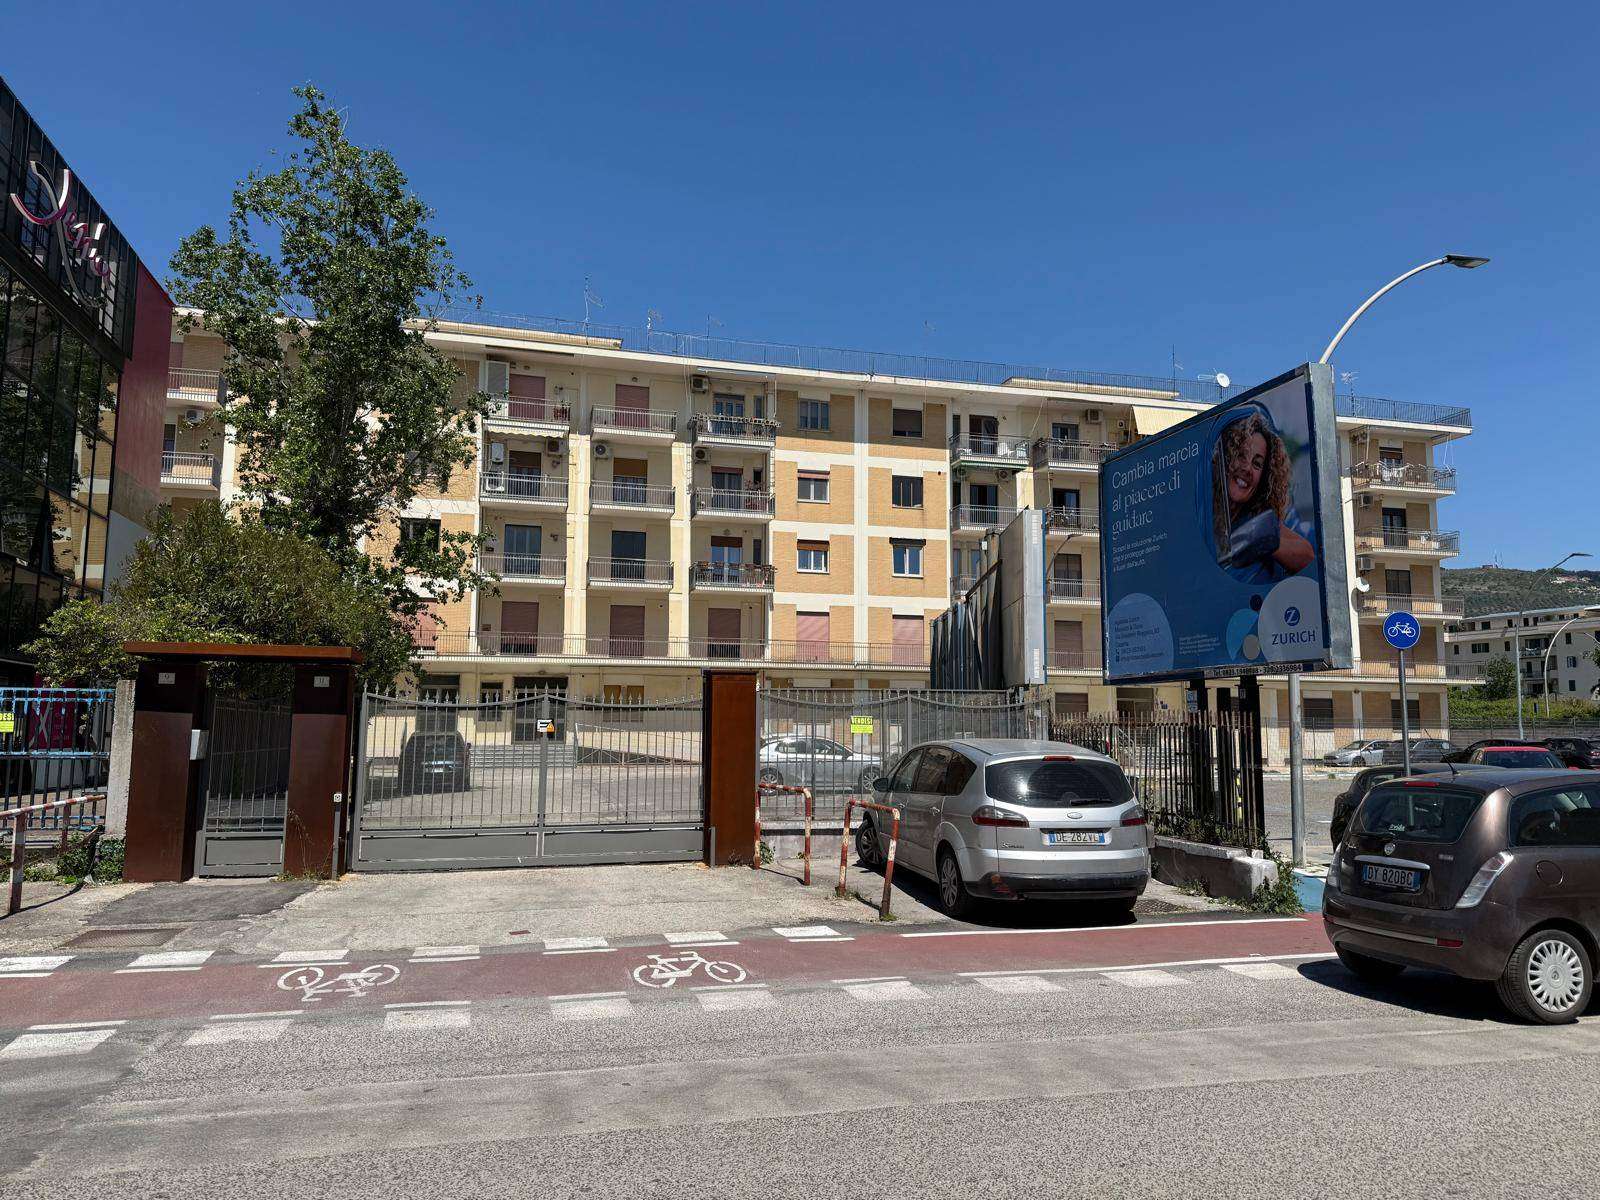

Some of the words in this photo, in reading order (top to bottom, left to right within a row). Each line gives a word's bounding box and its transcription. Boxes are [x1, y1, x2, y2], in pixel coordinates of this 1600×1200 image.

[1112, 460, 1154, 489] Cambia
[1158, 441, 1199, 470] marcia
[1112, 494, 1121, 512] al
[1124, 481, 1166, 513] piacere
[1168, 469, 1180, 491] di
[1112, 510, 1153, 540] guidare
[1271, 630, 1317, 646] ZURICH
